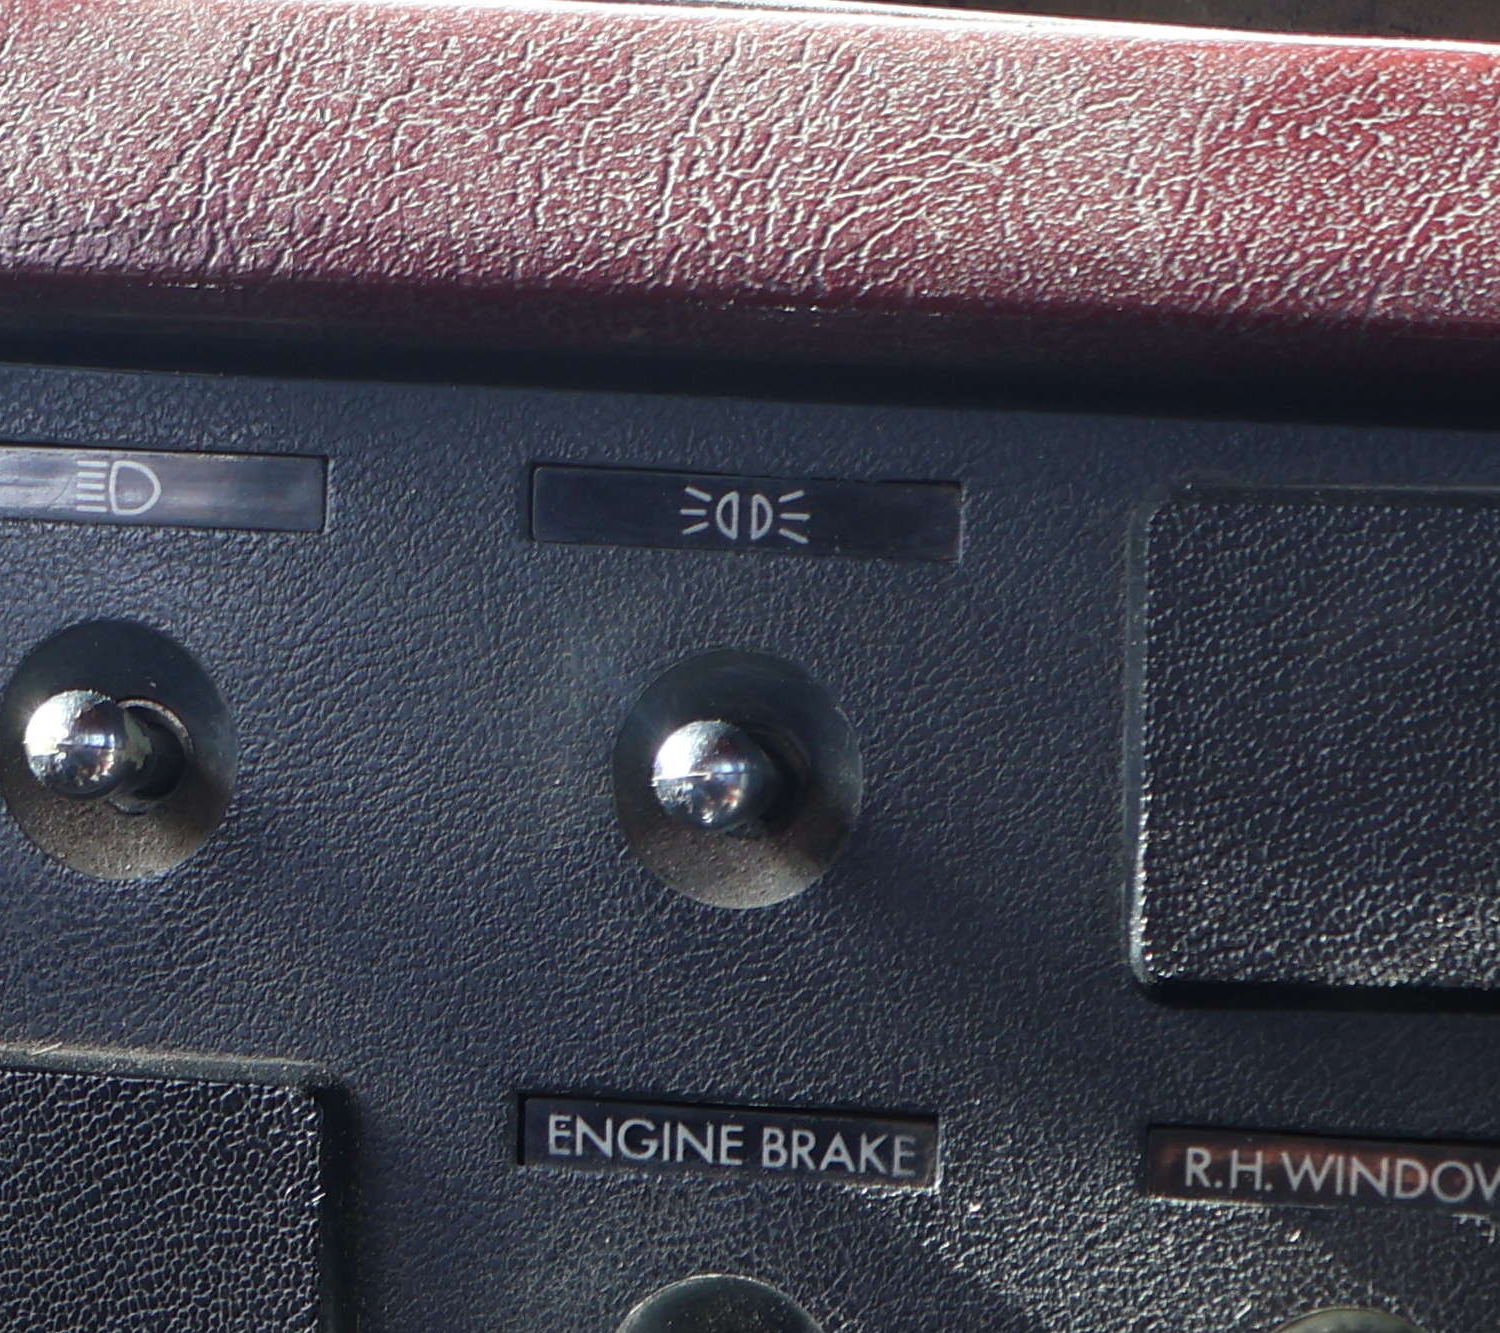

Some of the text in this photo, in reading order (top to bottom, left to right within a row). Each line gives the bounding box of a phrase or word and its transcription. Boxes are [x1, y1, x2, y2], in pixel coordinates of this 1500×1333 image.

[547, 1113, 916, 1178] ENGINE BRAKE
[1185, 1146, 1274, 1192] R.H.
